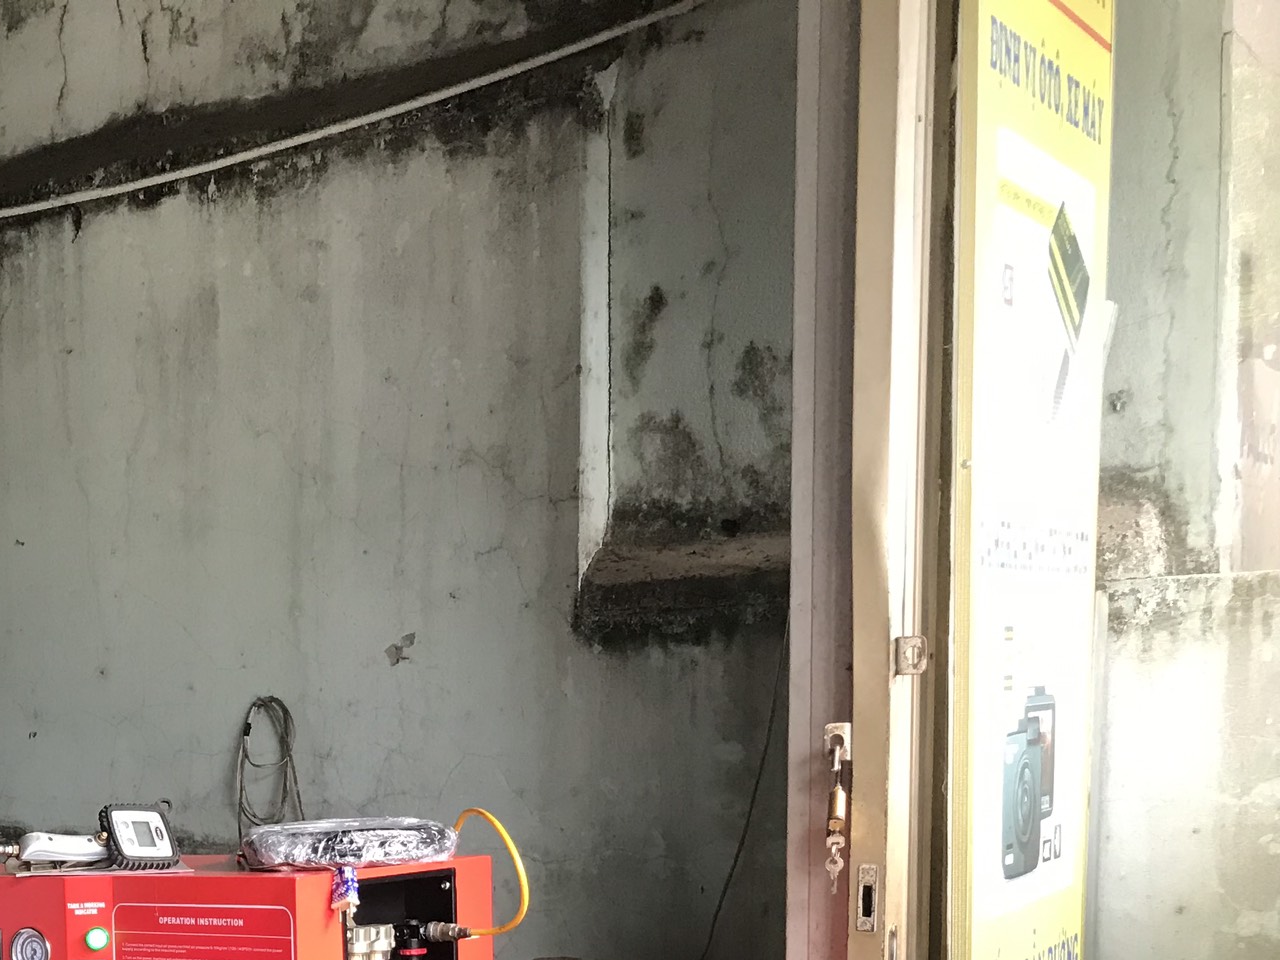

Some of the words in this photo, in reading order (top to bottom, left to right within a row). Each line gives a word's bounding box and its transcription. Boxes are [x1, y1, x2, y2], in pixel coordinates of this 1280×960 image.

[1066, 73, 1080, 129] XE
[158, 916, 196, 925] OPERATION
[197, 917, 244, 927] INSTRUCTION
